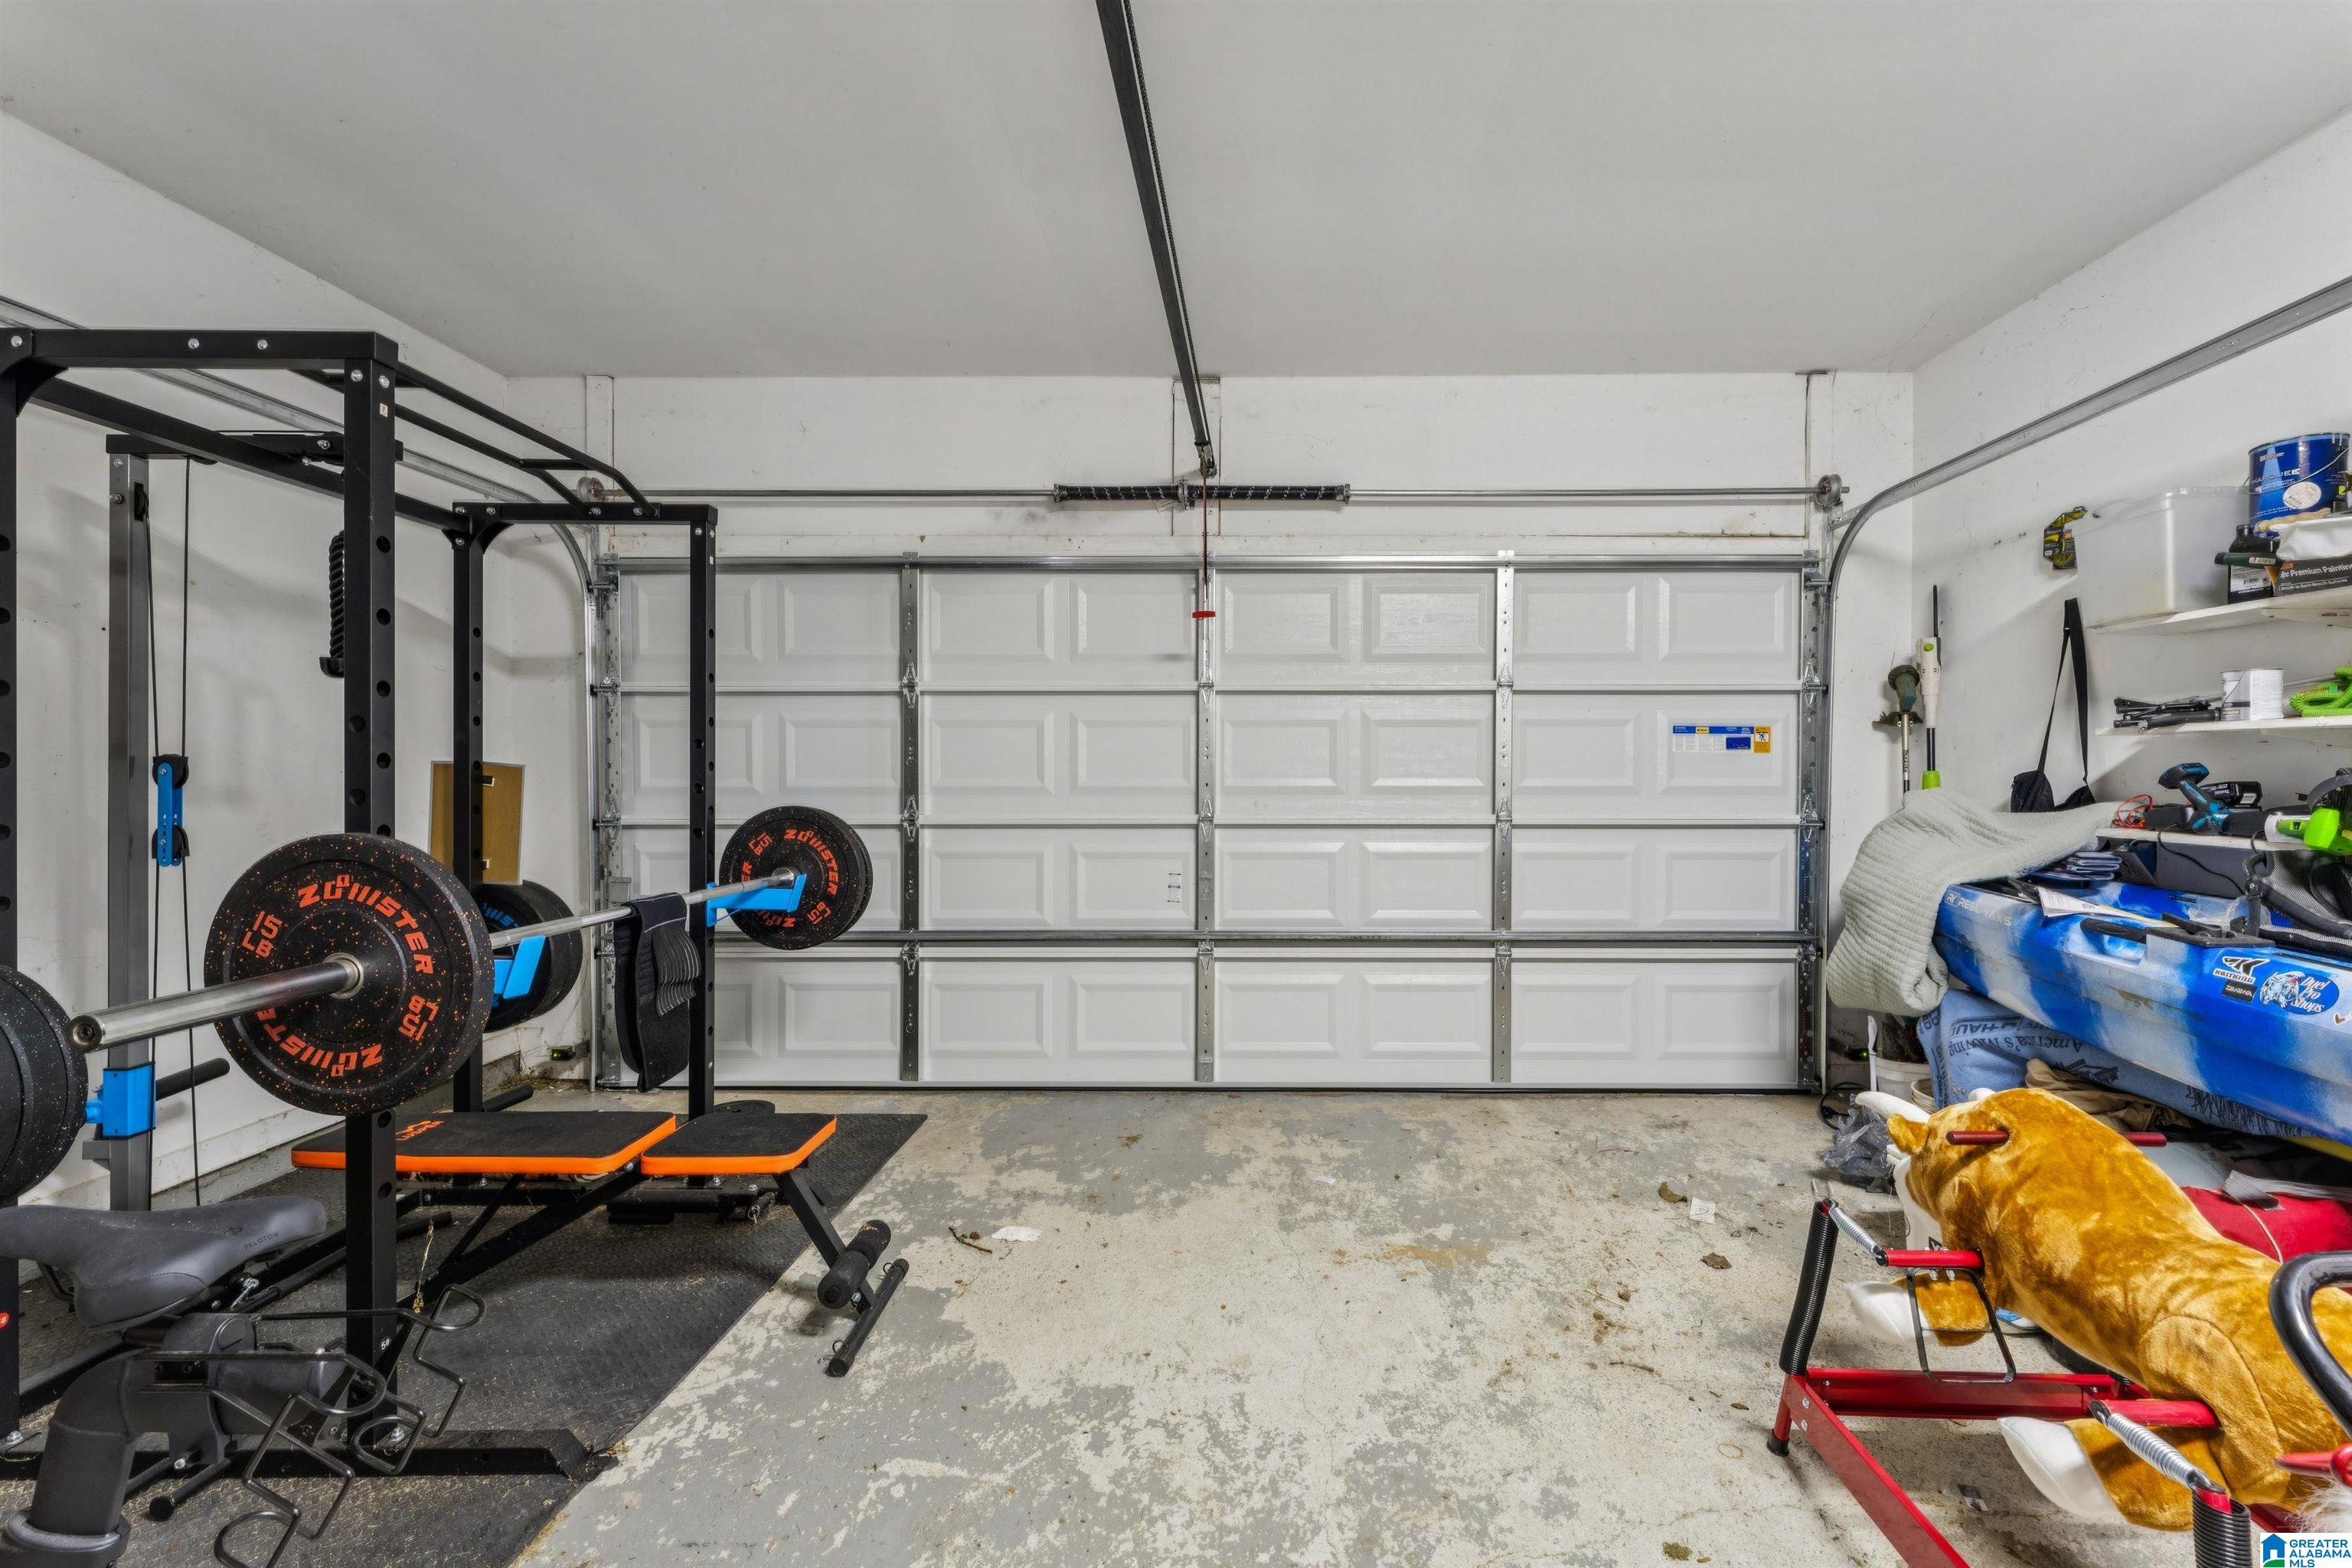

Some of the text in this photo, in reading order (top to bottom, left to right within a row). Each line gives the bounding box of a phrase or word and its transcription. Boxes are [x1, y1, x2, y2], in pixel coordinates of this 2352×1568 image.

[2290, 568, 2322, 577] Premium
[252, 910, 283, 939] 15
[241, 931, 273, 957] LB
[2300, 976, 2331, 990] Duel
[2302, 986, 2321, 1000] Pro
[408, 995, 439, 1021] LB
[2290, 995, 2325, 1012] Shops
[398, 1013, 428, 1041] 15
